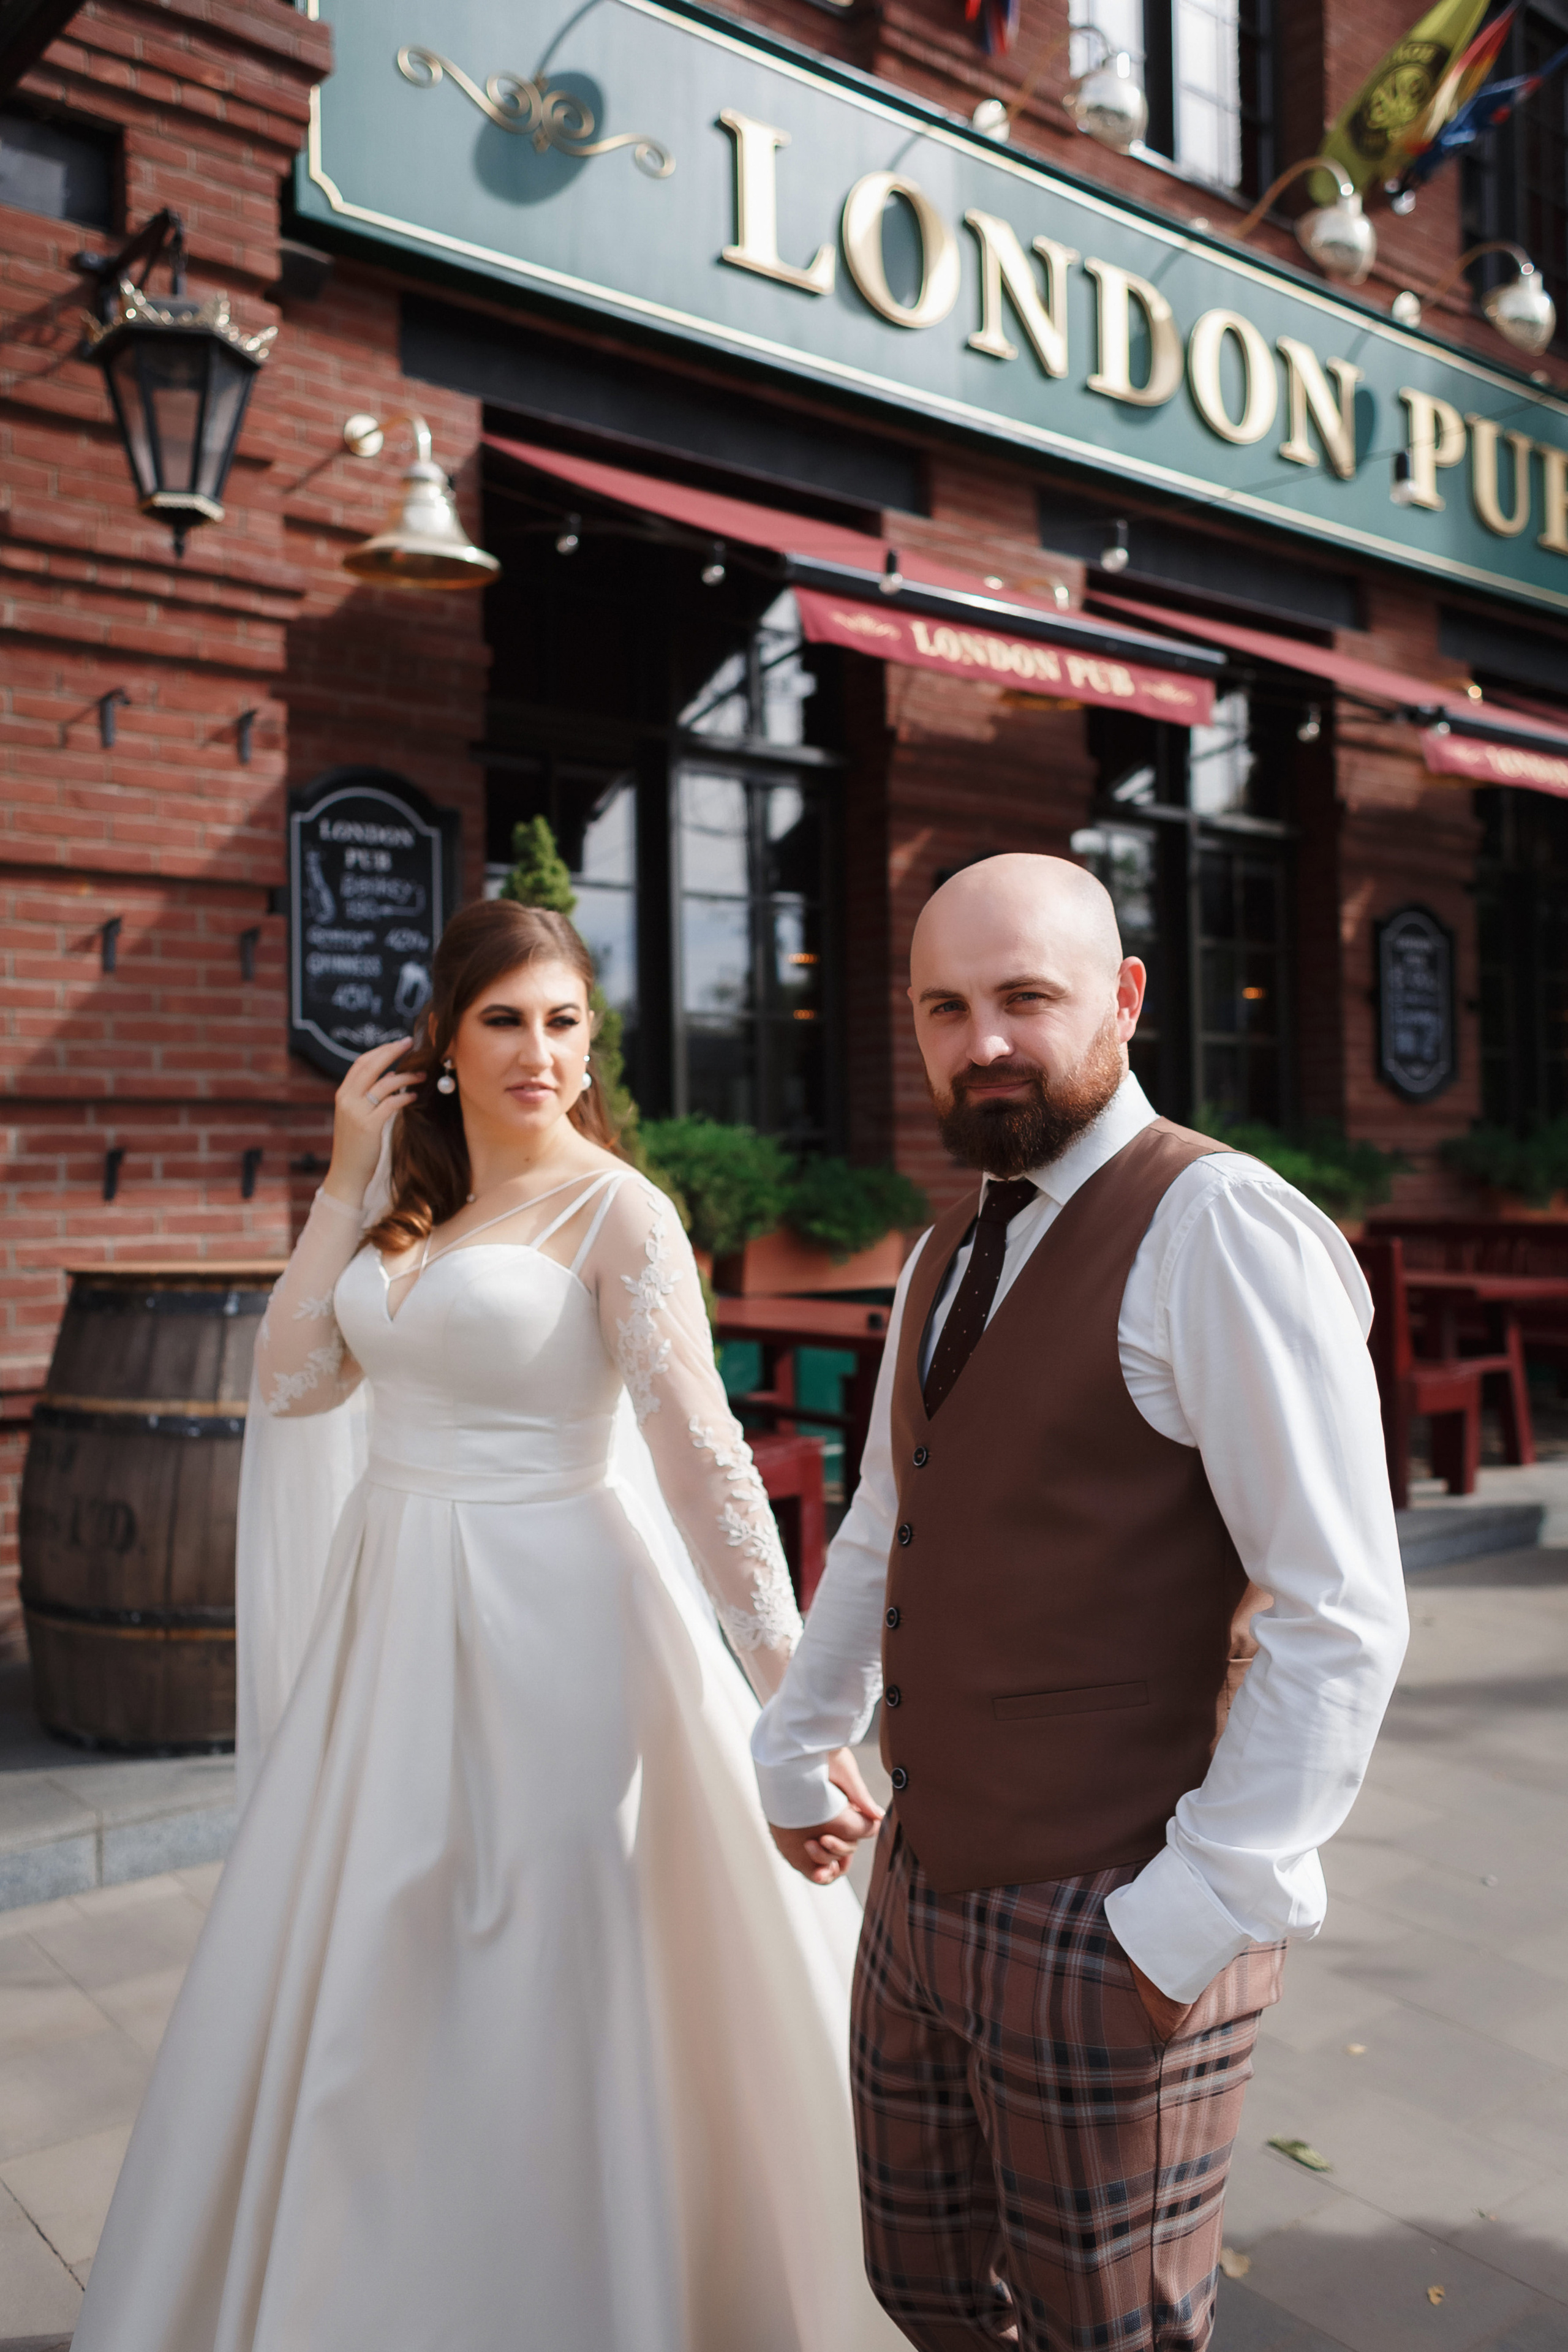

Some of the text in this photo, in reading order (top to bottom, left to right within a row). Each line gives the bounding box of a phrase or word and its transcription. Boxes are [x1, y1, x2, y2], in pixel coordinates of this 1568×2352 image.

[719, 109, 1364, 479] LONDON
[910, 620, 1135, 697] LONDON PUB
[318, 818, 415, 849] LONDON
[345, 846, 393, 873] PUB
